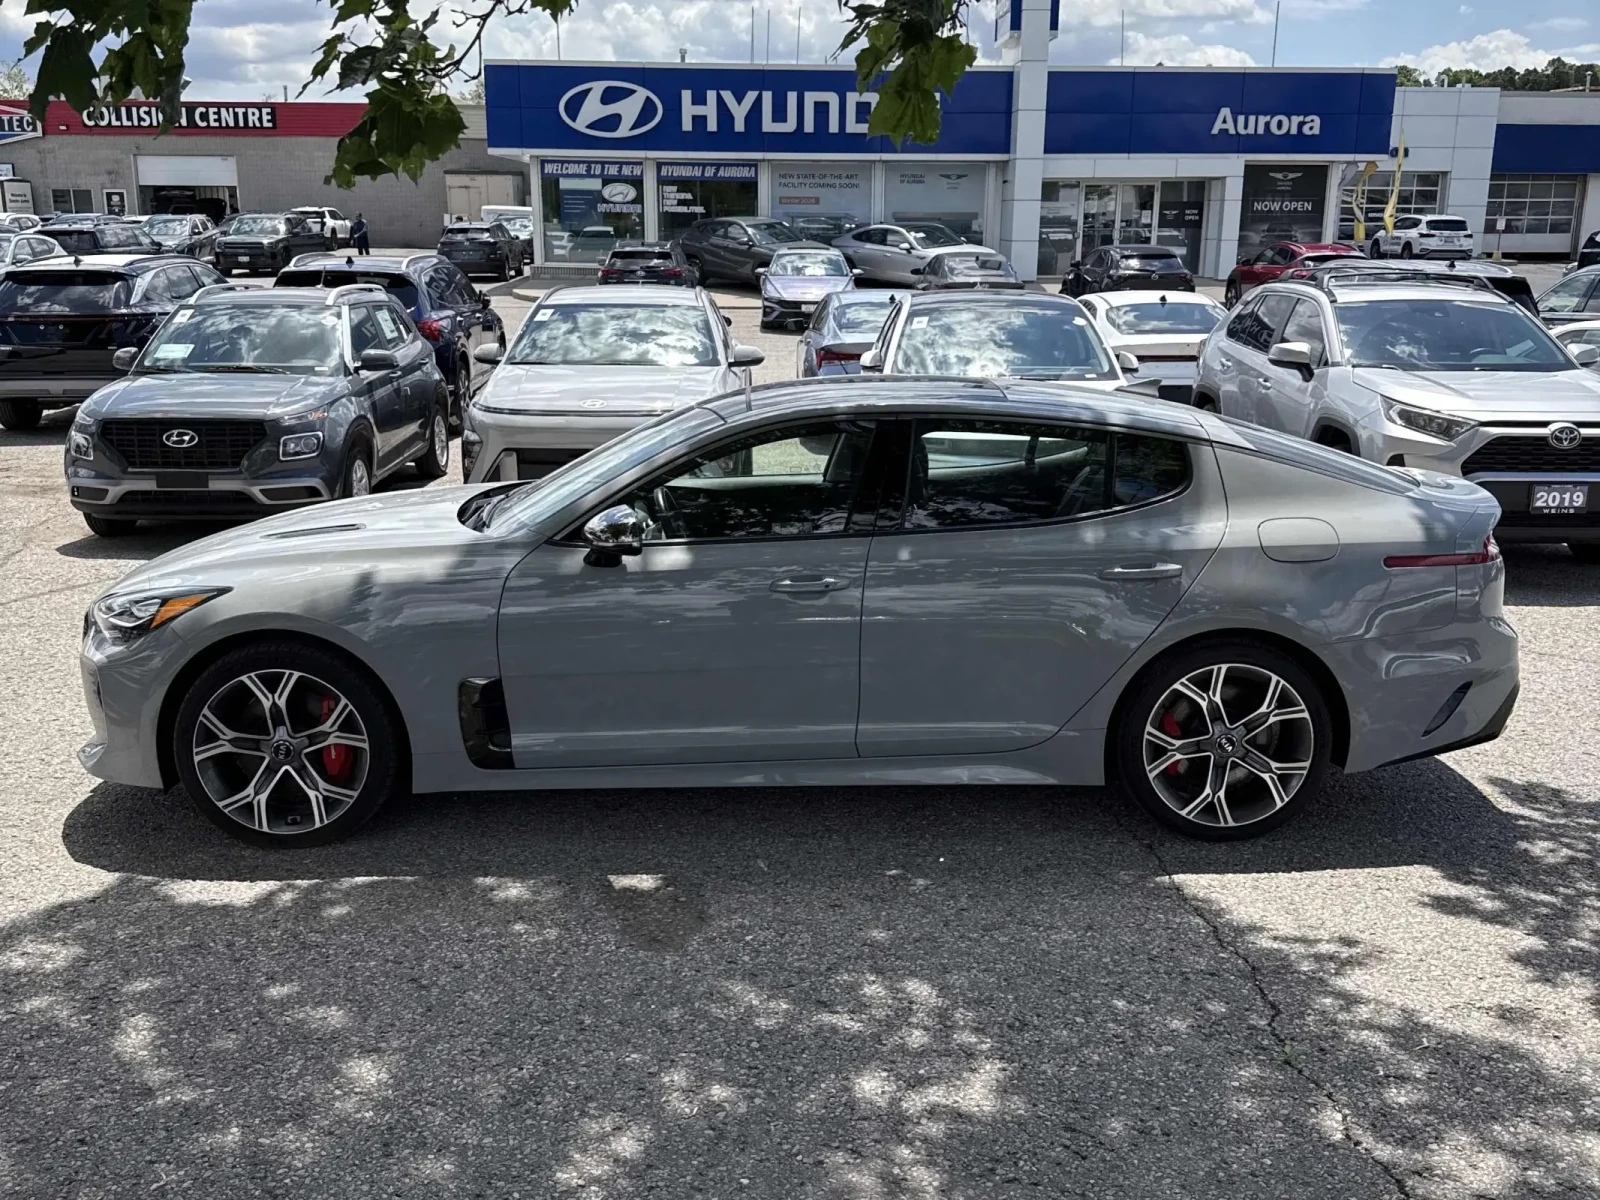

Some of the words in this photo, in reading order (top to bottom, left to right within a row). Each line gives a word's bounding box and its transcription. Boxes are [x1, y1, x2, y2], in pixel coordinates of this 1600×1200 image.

[1, 116, 33, 131] TEC
[194, 107, 273, 127] CENTRE
[1210, 107, 1321, 135] Aurora
[544, 163, 588, 175] WELCOME
[590, 163, 602, 175] TO
[604, 164, 619, 175] THE
[621, 165, 643, 176] NEW
[661, 165, 702, 177] HYUNDAI
[704, 166, 717, 177] OF
[717, 167, 755, 178] AURORA
[1253, 201, 1281, 211] NOW
[1282, 202, 1312, 211] OPEN
[1535, 491, 1584, 507] 2019
